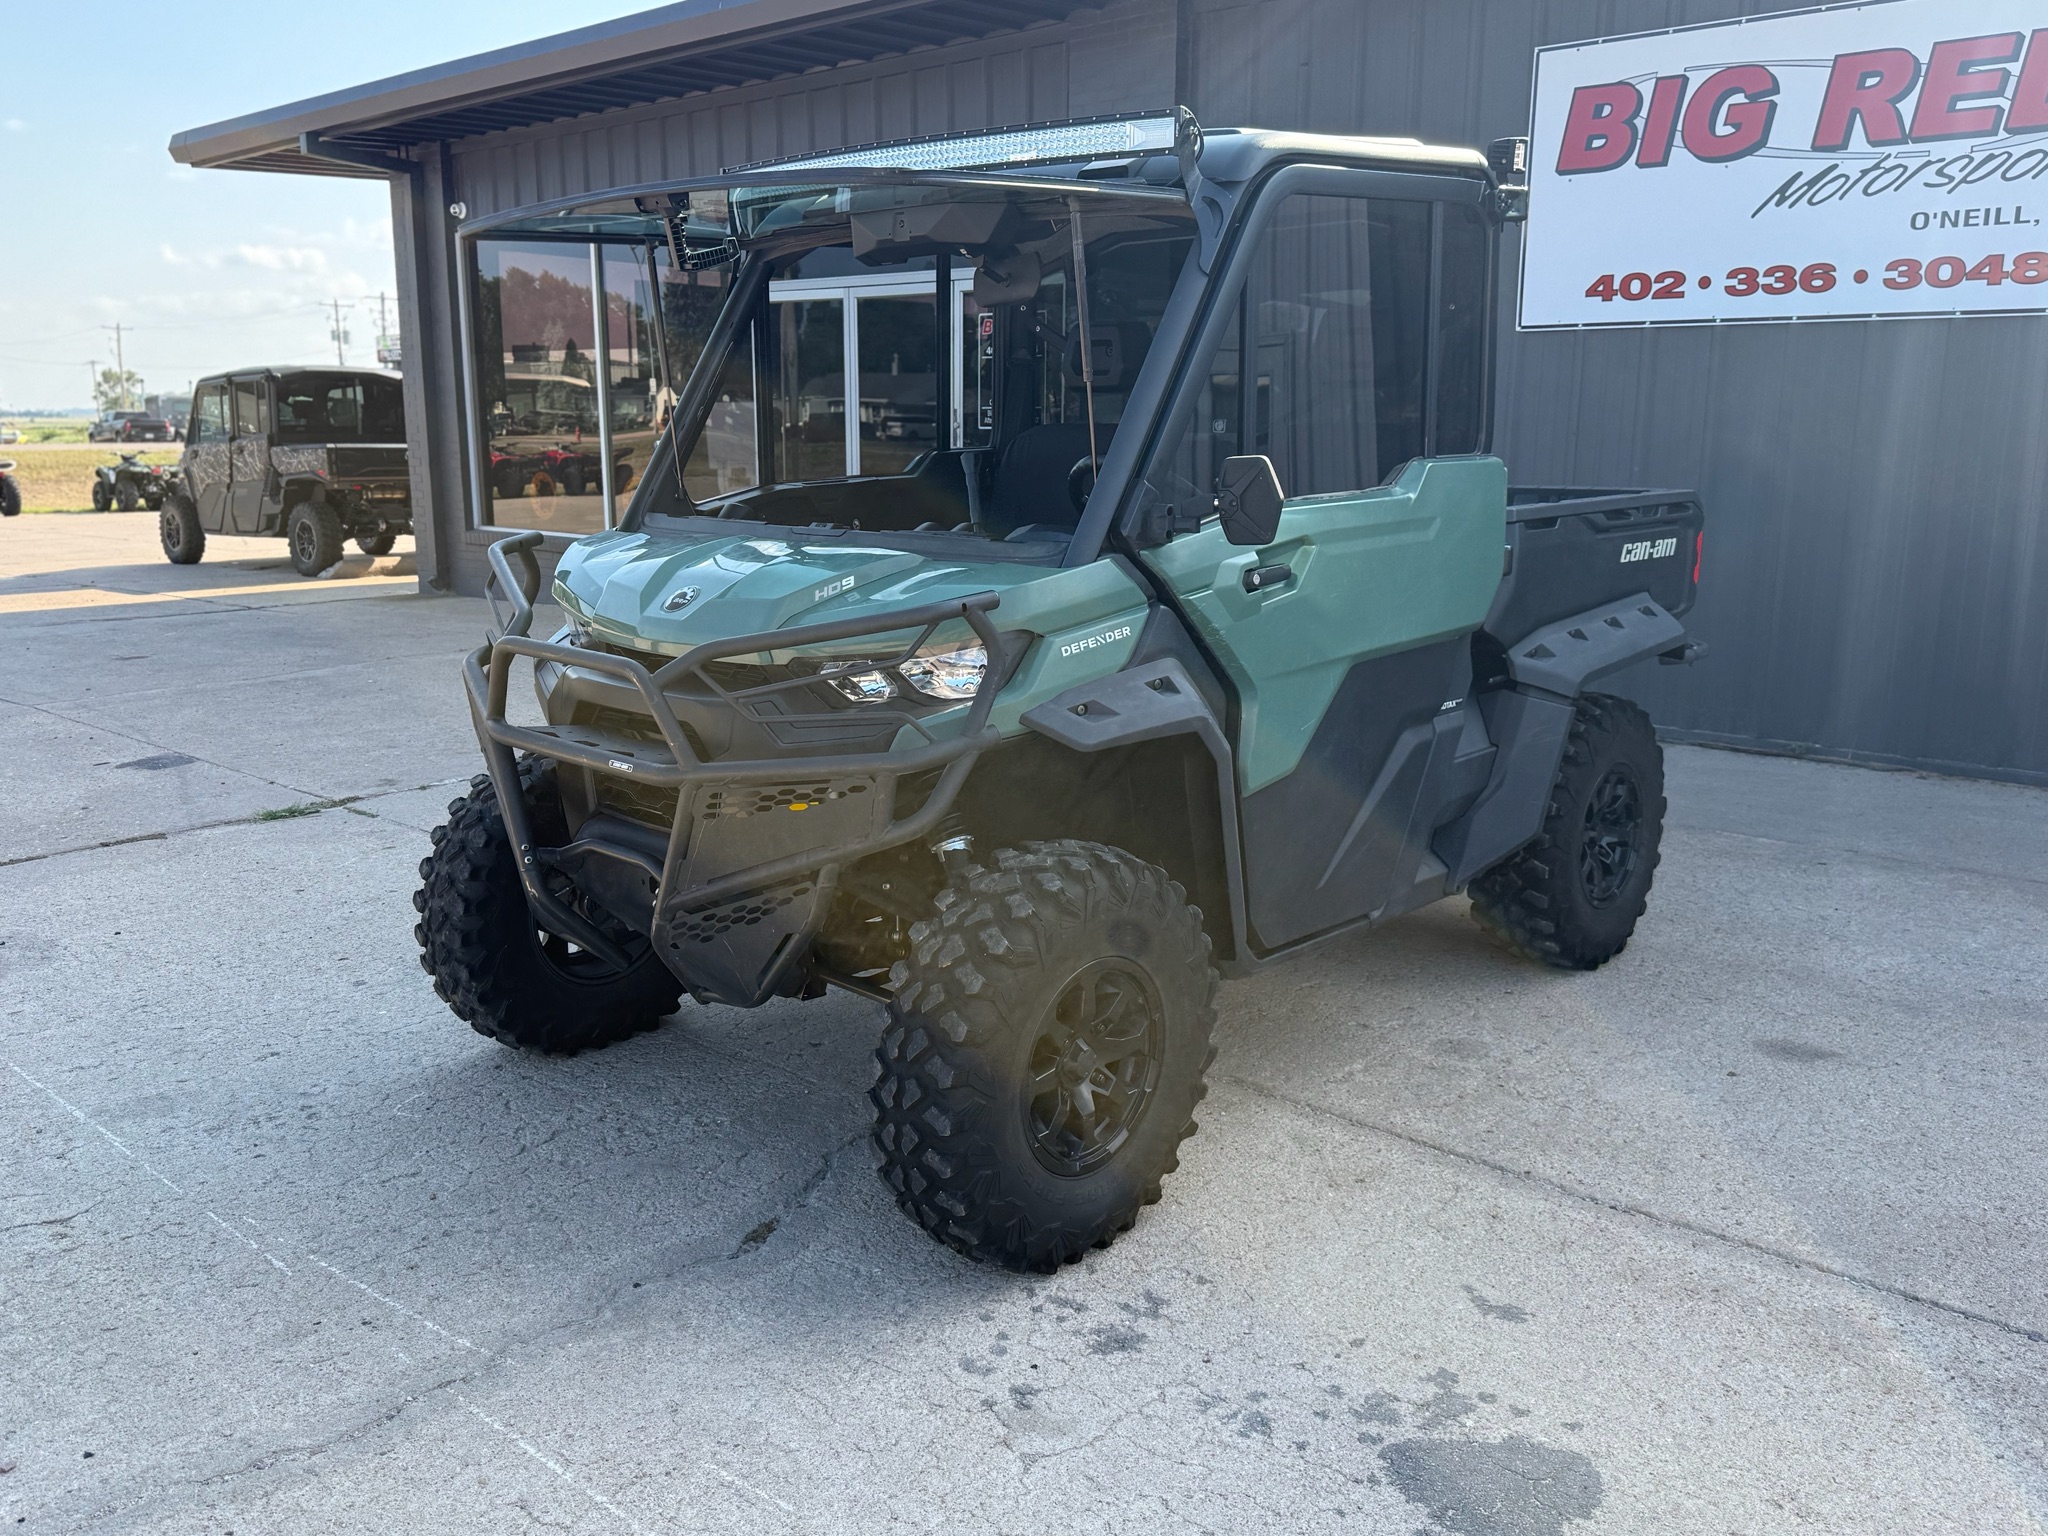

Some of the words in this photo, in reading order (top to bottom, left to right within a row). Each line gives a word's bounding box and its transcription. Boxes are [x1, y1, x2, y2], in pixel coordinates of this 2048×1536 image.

[1555, 64, 1780, 176] BIG
[1910, 205, 2040, 230] O'NEILL,
[1585, 270, 1687, 302] 402
[1723, 262, 1837, 297] 336
[1882, 251, 2048, 290] 3048
[1620, 538, 1677, 563] can-am
[814, 575, 855, 602] HD9
[1061, 626, 1131, 657] DEFENDER
